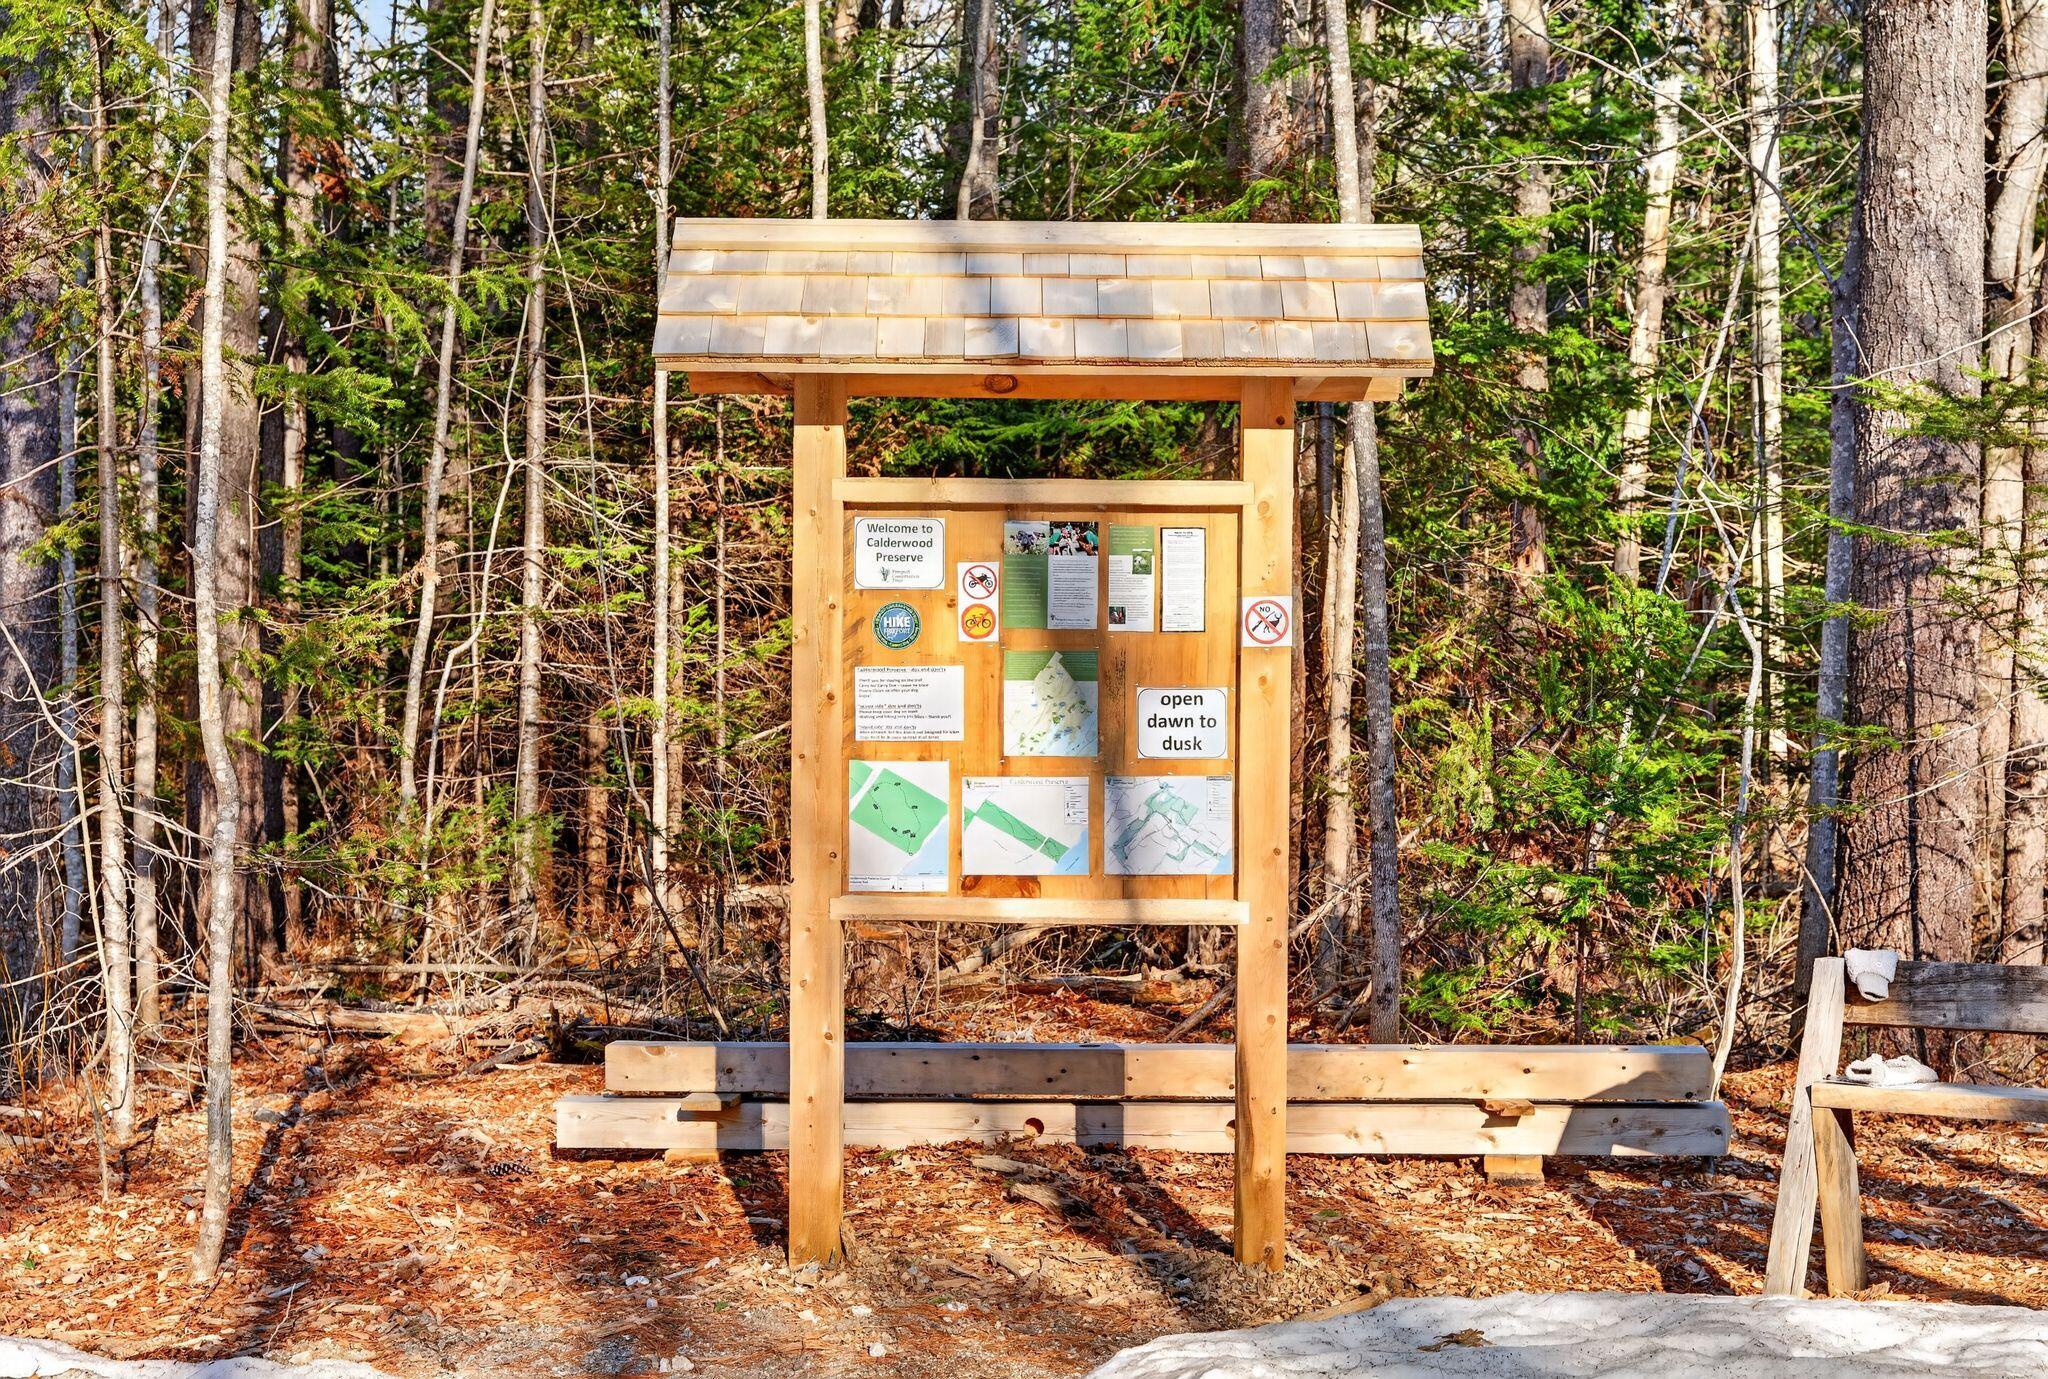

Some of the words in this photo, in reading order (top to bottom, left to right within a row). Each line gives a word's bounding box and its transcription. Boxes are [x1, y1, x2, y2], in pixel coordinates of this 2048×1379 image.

[867, 523, 918, 533] Welcome
[922, 524, 933, 534] to
[867, 537, 933, 548] Calderwood
[876, 552, 923, 562] Preserve
[883, 616, 911, 628] HIKE
[1160, 694, 1204, 709] open
[1147, 713, 1194, 728] dawn
[1199, 714, 1217, 728] to
[1162, 735, 1202, 750] dusk
